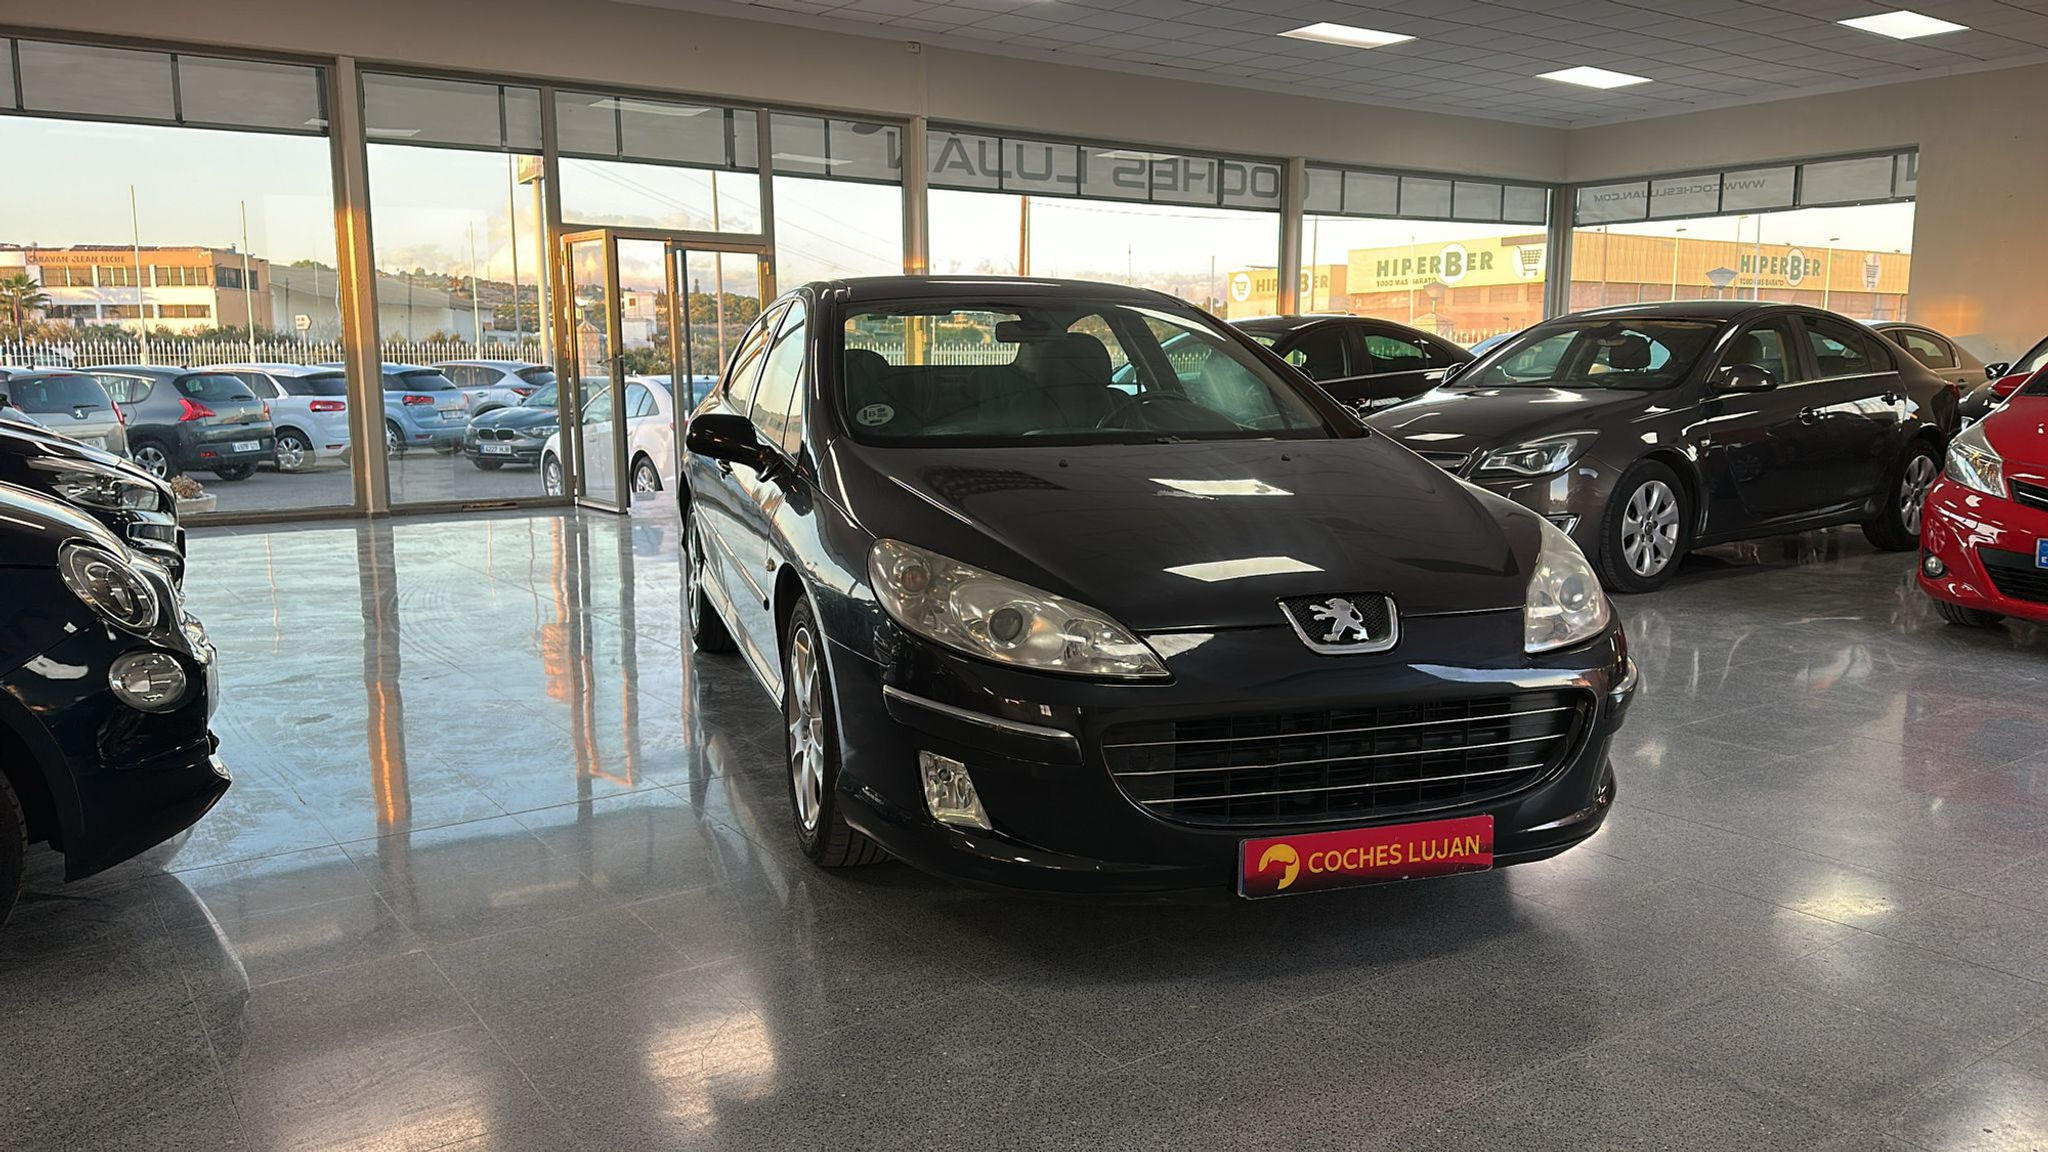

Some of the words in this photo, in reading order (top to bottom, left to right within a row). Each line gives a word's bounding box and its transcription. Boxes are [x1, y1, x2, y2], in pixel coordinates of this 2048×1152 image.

[1376, 251, 1493, 277] HIPERBER
[1741, 255, 1820, 280] HIPERBER
[1308, 844, 1402, 874] COCHES
[1409, 835, 1481, 863] LUJAN
